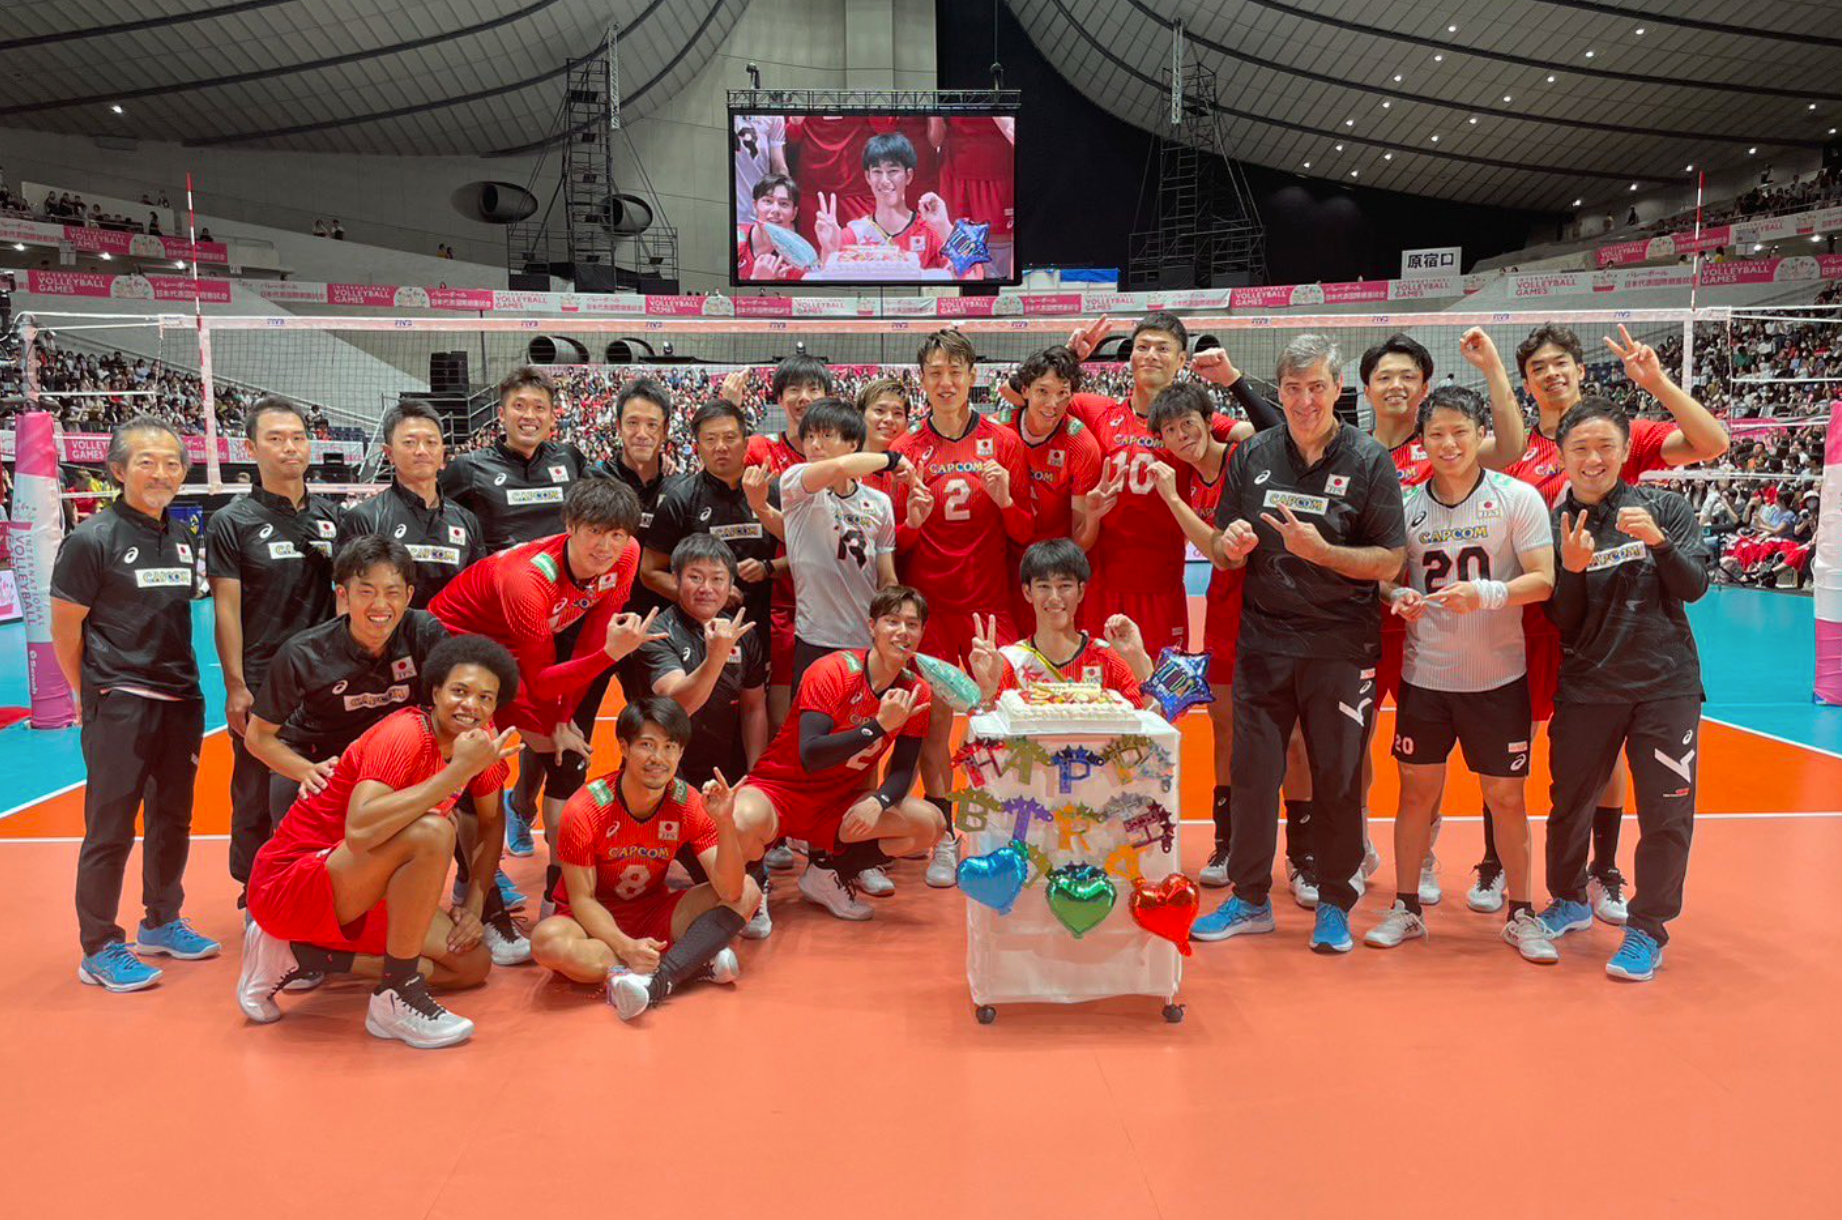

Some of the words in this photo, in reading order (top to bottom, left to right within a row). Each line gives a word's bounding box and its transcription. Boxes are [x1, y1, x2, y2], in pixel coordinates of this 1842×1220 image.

[1407, 252, 1454, 269] 原宿口
[1702, 265, 1769, 277] VOLLEYBALL
[38, 277, 106, 288] VOLLEYBALL
[1516, 279, 1577, 289] VOLLEYBALL
[1702, 275, 1738, 285] GAMES
[39, 285, 75, 294] GAMES
[1395, 281, 1450, 292] VOLLEYBALL
[1516, 287, 1547, 296] GAMES
[334, 290, 390, 299] VOLLEYBALL
[496, 295, 548, 304] VOLLEYBALL
[1235, 290, 1287, 300] VOLLEYBALL
[1395, 290, 1424, 298] GAMES
[649, 299, 699, 308] VOLLEYBALL
[940, 301, 989, 309] VOLLEYBALL
[1235, 297, 1263, 306] GAMES
[72, 439, 111, 450] VOLLEY
[72, 450, 104, 461] GAMES
[930, 461, 983, 474] CAPCOM
[1112, 450, 1155, 495] 10
[511, 492, 560, 502] CAPCOM
[944, 479, 971, 521] 2
[1269, 493, 1323, 511] CAPCOM
[713, 526, 760, 538] CAPCOM
[1418, 525, 1489, 544] CAPCOM
[411, 546, 457, 563] CAPCOM
[1422, 546, 1490, 595] 20
[13, 535, 35, 627] VOLLEYBALL
[142, 571, 190, 584] CAPCOM
[350, 688, 407, 708] CAPCOM
[1394, 733, 1414, 755] 20
[608, 846, 669, 859] CAPCOM
[614, 864, 651, 901] 8
